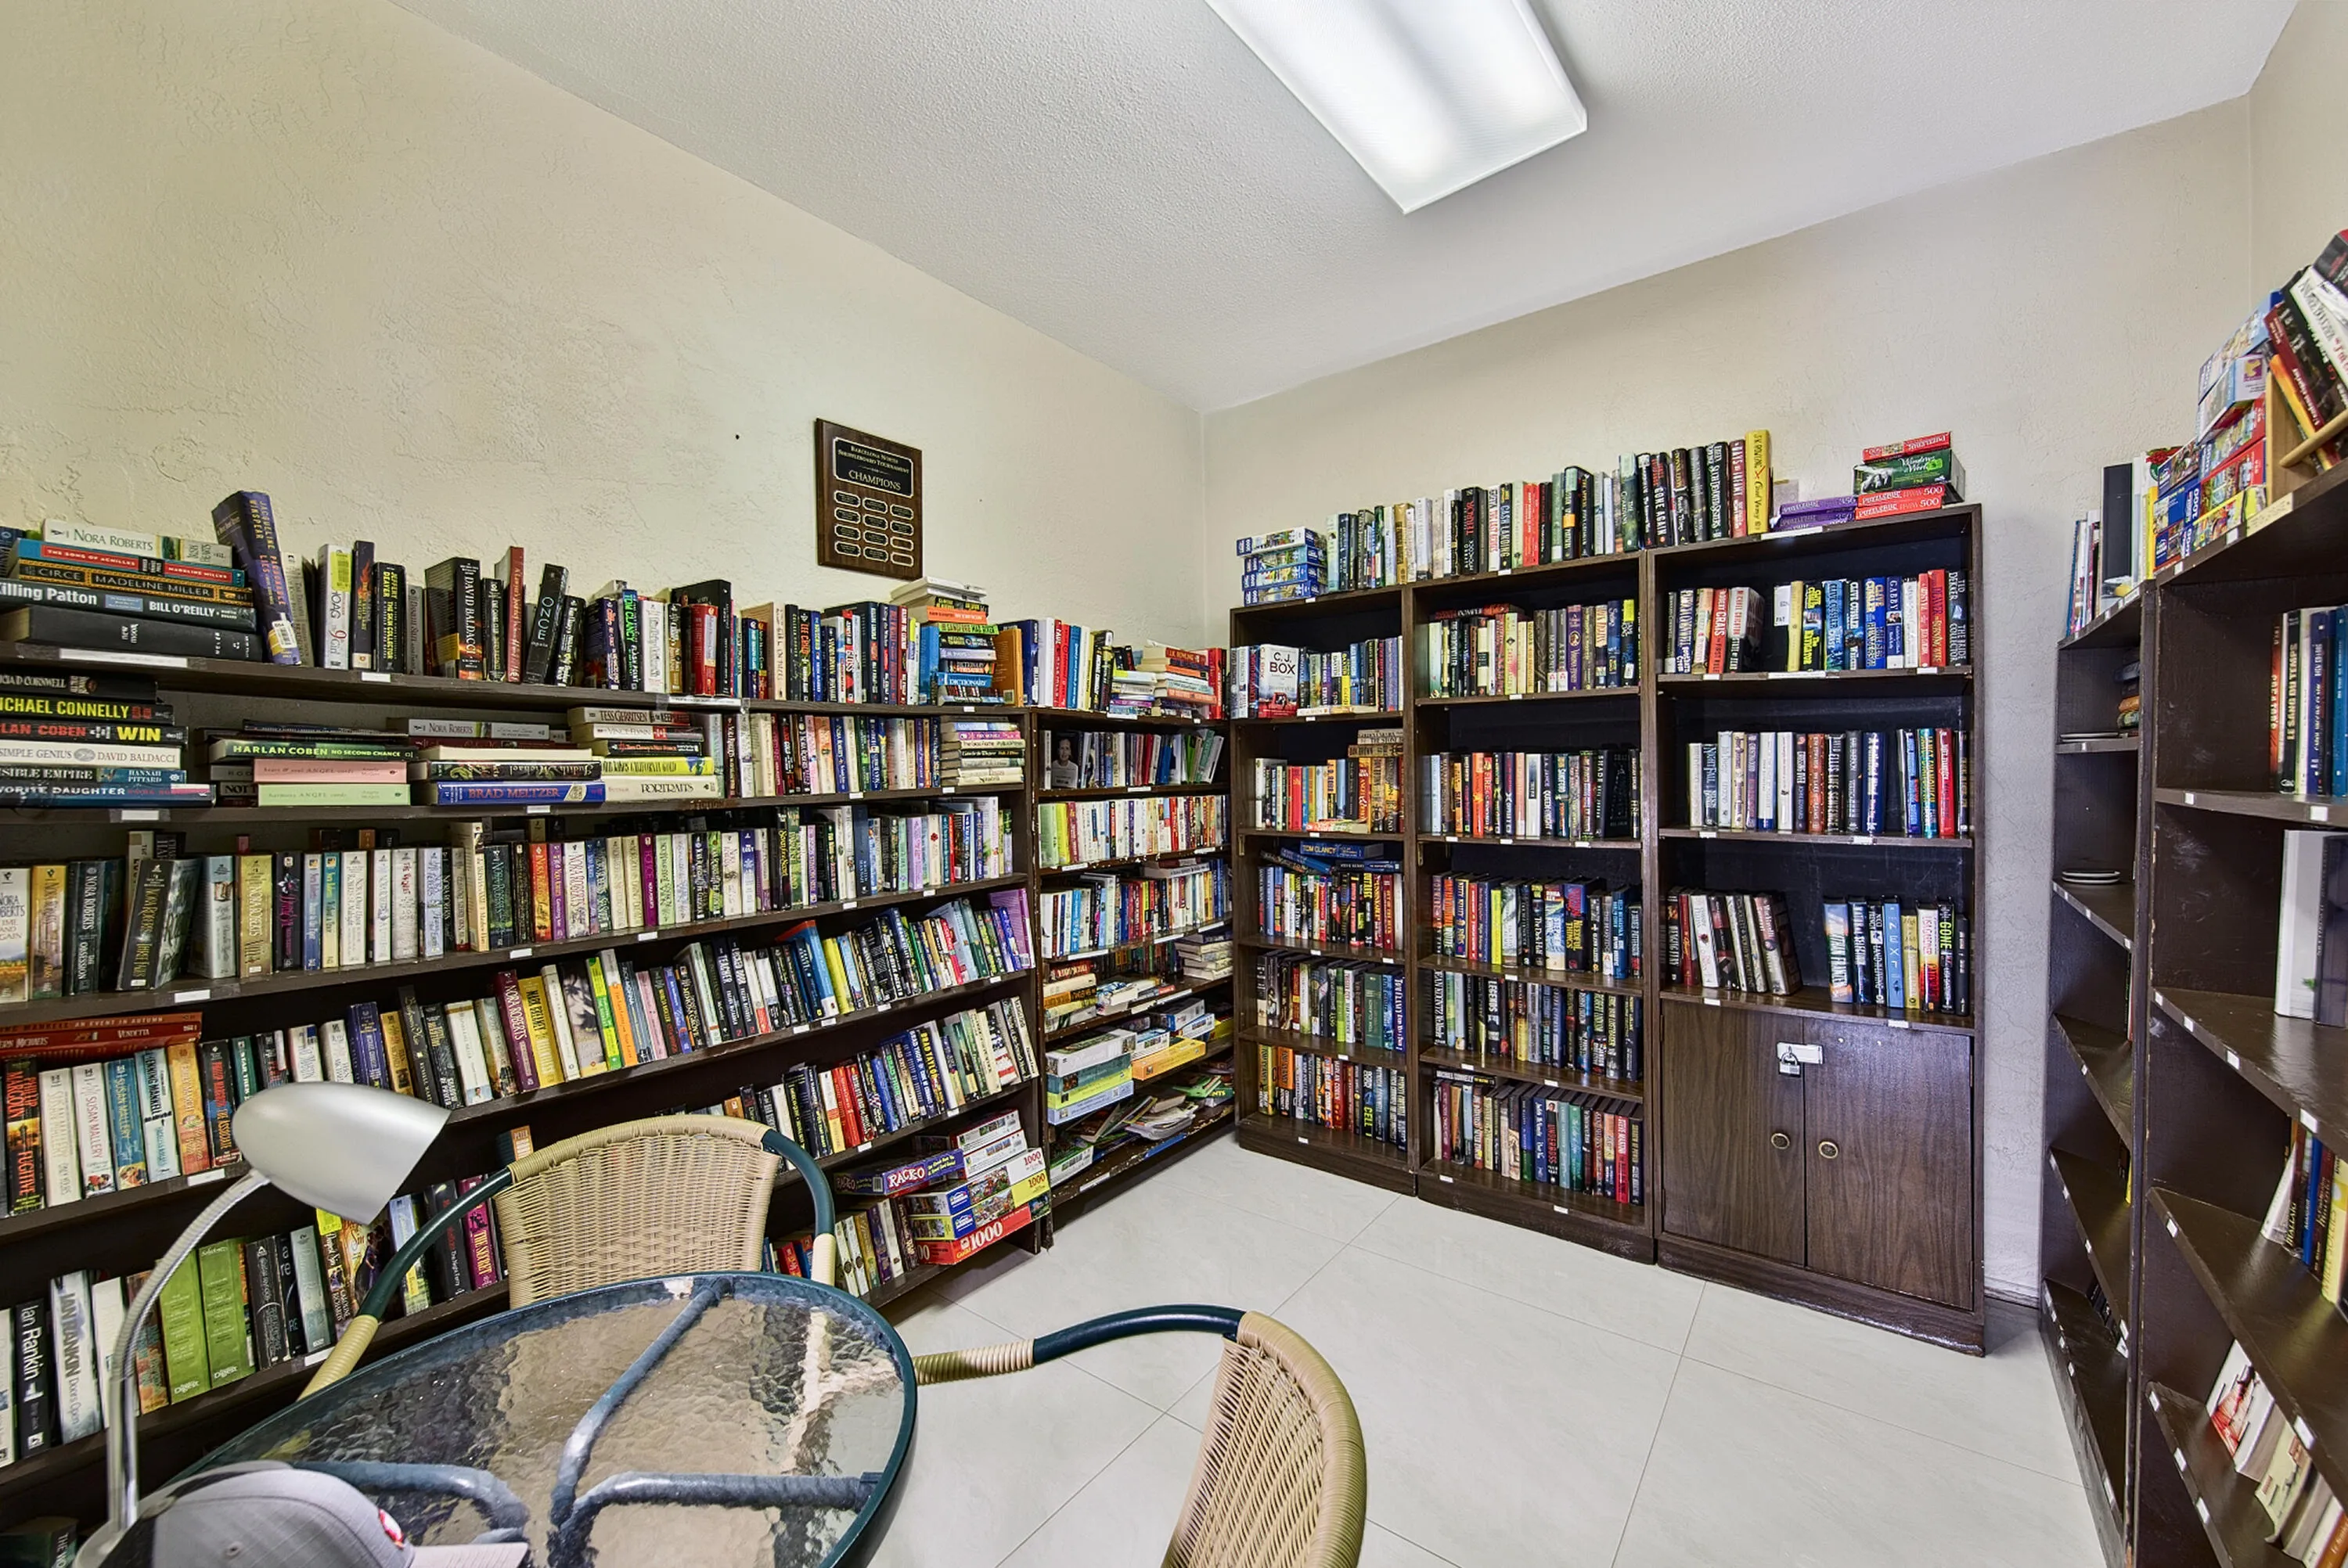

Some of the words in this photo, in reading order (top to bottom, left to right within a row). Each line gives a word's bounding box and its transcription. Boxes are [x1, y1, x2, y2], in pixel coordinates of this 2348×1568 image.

[877, 459, 909, 473] TOURNAMENT
[848, 469, 901, 491] CHAMPIONS
[1654, 487, 1664, 509] GONE
[1923, 486, 1943, 497] 500
[1919, 498, 1940, 508] 500
[1464, 501, 1475, 535] TERROR
[1656, 510, 1667, 535] AGAIN
[74, 528, 106, 545] NORA
[110, 534, 153, 551] ROBERTS
[63, 550, 85, 559] SONG
[39, 567, 81, 581] CIRCE
[0, 581, 42, 601] illing
[47, 585, 98, 606] Patton
[95, 575, 164, 591] MADELINE
[168, 581, 211, 597] MILLER
[465, 577, 476, 606] DAVID
[1889, 580, 1899, 610] GABBY
[1949, 572, 1958, 601] DEKKER
[149, 601, 171, 613] BILL
[173, 603, 216, 618] O'REILLY
[624, 594, 633, 609] TOM
[466, 608, 477, 654] BALDACCI
[625, 610, 636, 642] CLANCY
[1714, 611, 1727, 636] CRAIS
[1949, 623, 1958, 662] COLLECTOR
[1269, 661, 1296, 675] BOX
[1273, 652, 1284, 663] C.
[1286, 653, 1293, 665] J.
[949, 678, 987, 687] DICTIONARY
[56, 701, 129, 718] CONNELLY
[600, 710, 614, 721] TESS
[38, 725, 86, 736] COBEN
[117, 726, 160, 742] WIN
[429, 723, 448, 732] NORA
[448, 725, 473, 735] ROBERTS
[36, 750, 73, 758] GENIUS
[97, 751, 127, 761] DAVID
[130, 753, 175, 764] BALDACCI
[233, 746, 285, 755] HARLAN
[289, 746, 327, 756] COBEN
[1827, 753, 1840, 771] ELLIS
[43, 769, 92, 779] EMPIRE
[1828, 774, 1839, 789] LIFE
[52, 786, 125, 795] DAUGHTER
[469, 786, 503, 797] BRAD
[507, 786, 560, 798] MELTZER
[641, 783, 693, 793] PORTRAITS
[1827, 791, 1839, 827] SENTENCE
[1302, 844, 1313, 853] TOM
[1314, 845, 1337, 854] CLANCY
[85, 876, 98, 897] NORA
[82, 898, 97, 930] ROBERTS
[1939, 921, 1952, 949] GONE
[78, 941, 88, 980] OBSESSION
[719, 955, 732, 984] TEACHER
[505, 984, 519, 1005] NORA
[1487, 980, 1498, 1012] LEGENDS
[509, 1005, 528, 1041] ROBERTS
[240, 1051, 249, 1071] STAR
[243, 1074, 251, 1095] TREK
[85, 1096, 97, 1124] SUSAN
[1363, 1106, 1374, 1127] CELL
[88, 1124, 101, 1159] MALLERY
[1024, 1151, 1042, 1166] 1000
[18, 1150, 36, 1196] FUGITIVE
[1028, 1174, 1046, 1188] 1000
[474, 1230, 489, 1246] THE
[970, 1221, 1003, 1251] 1000
[475, 1246, 493, 1276] SECRET
[21, 1304, 39, 1327] Ian
[59, 1292, 76, 1322] IAN
[22, 1328, 45, 1381] Rankin
[63, 1322, 81, 1378] RANKIN
[214, 1365, 238, 1379] Digest
[174, 1380, 200, 1394] Digest
